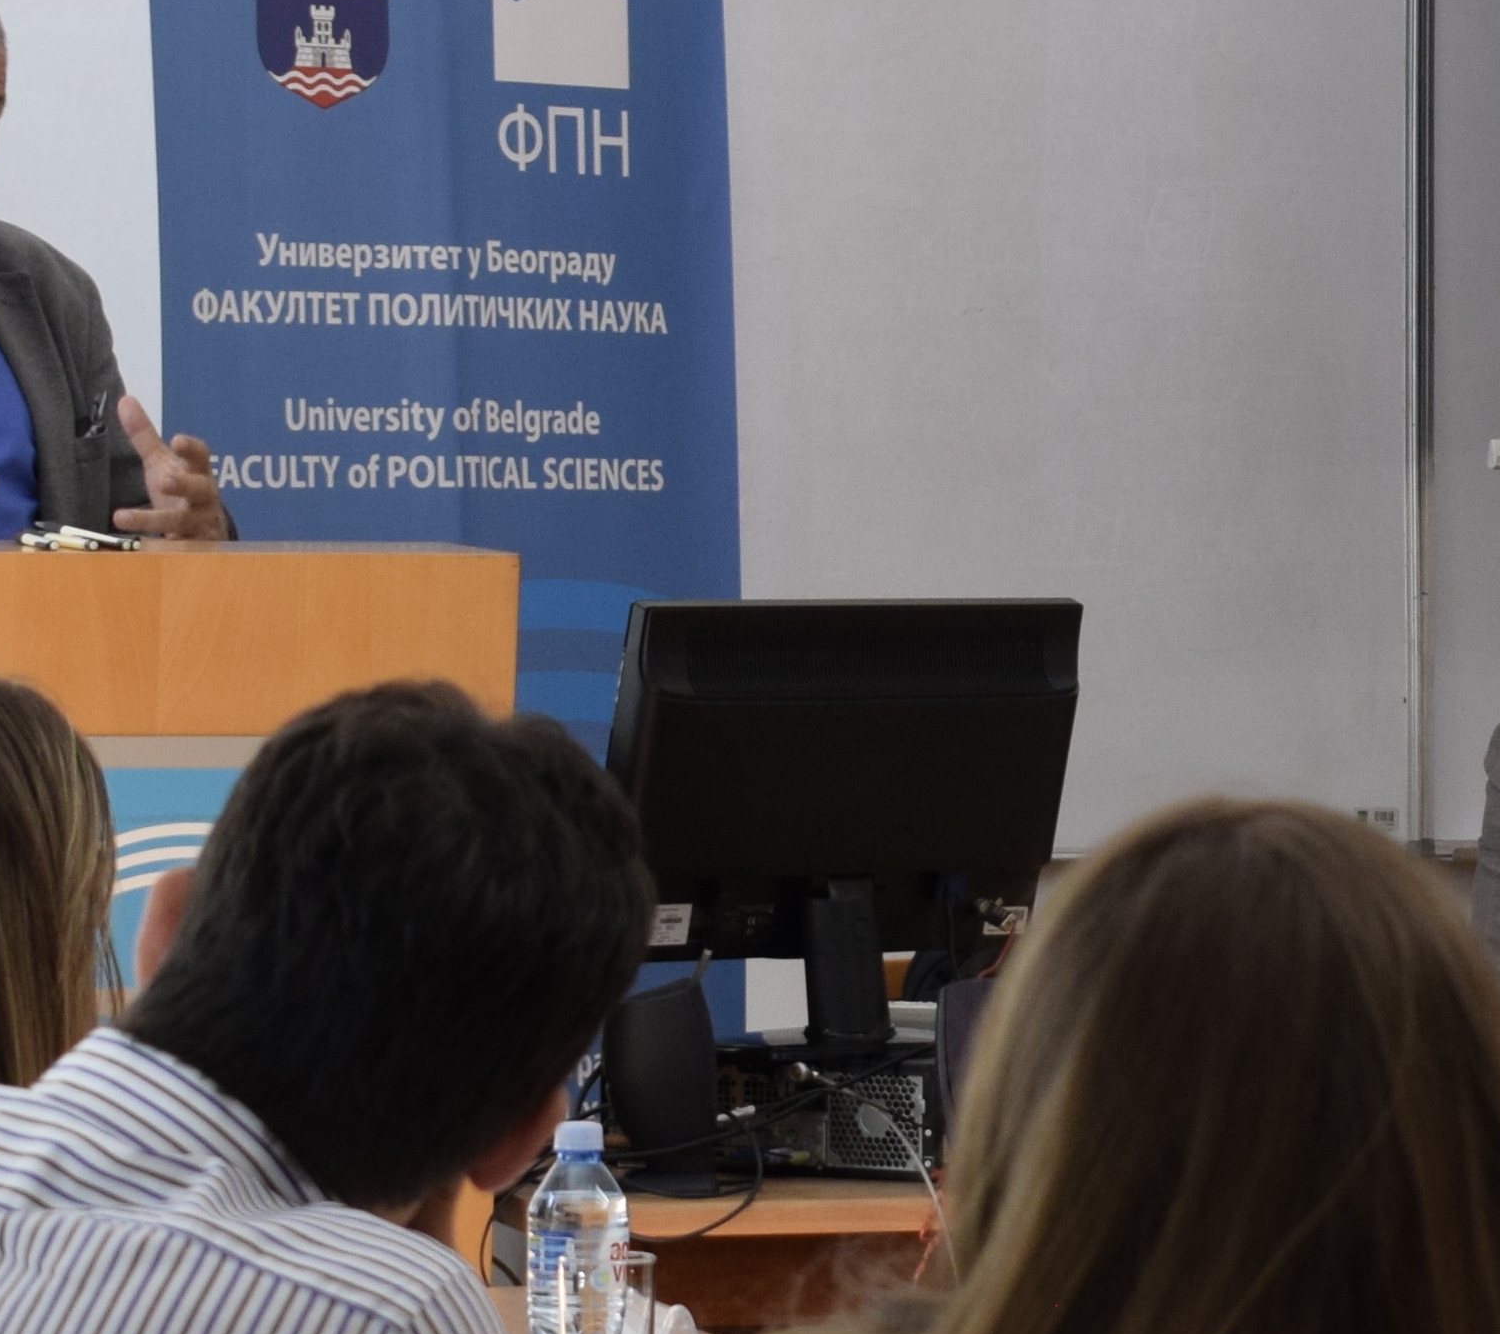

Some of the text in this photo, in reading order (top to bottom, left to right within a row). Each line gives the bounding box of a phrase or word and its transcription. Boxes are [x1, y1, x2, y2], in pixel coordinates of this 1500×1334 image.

[497, 103, 630, 178] ФПН
[256, 232, 617, 286] Универзитет у Београду
[192, 288, 669, 335] ФАКУЛТЕТ ПОЛИТИЧКИХ НАУКА
[284, 397, 601, 443] University of Belgrade
[347, 453, 380, 489] of
[387, 455, 537, 489] POLITICAL
[543, 457, 665, 492] SCIENCES
